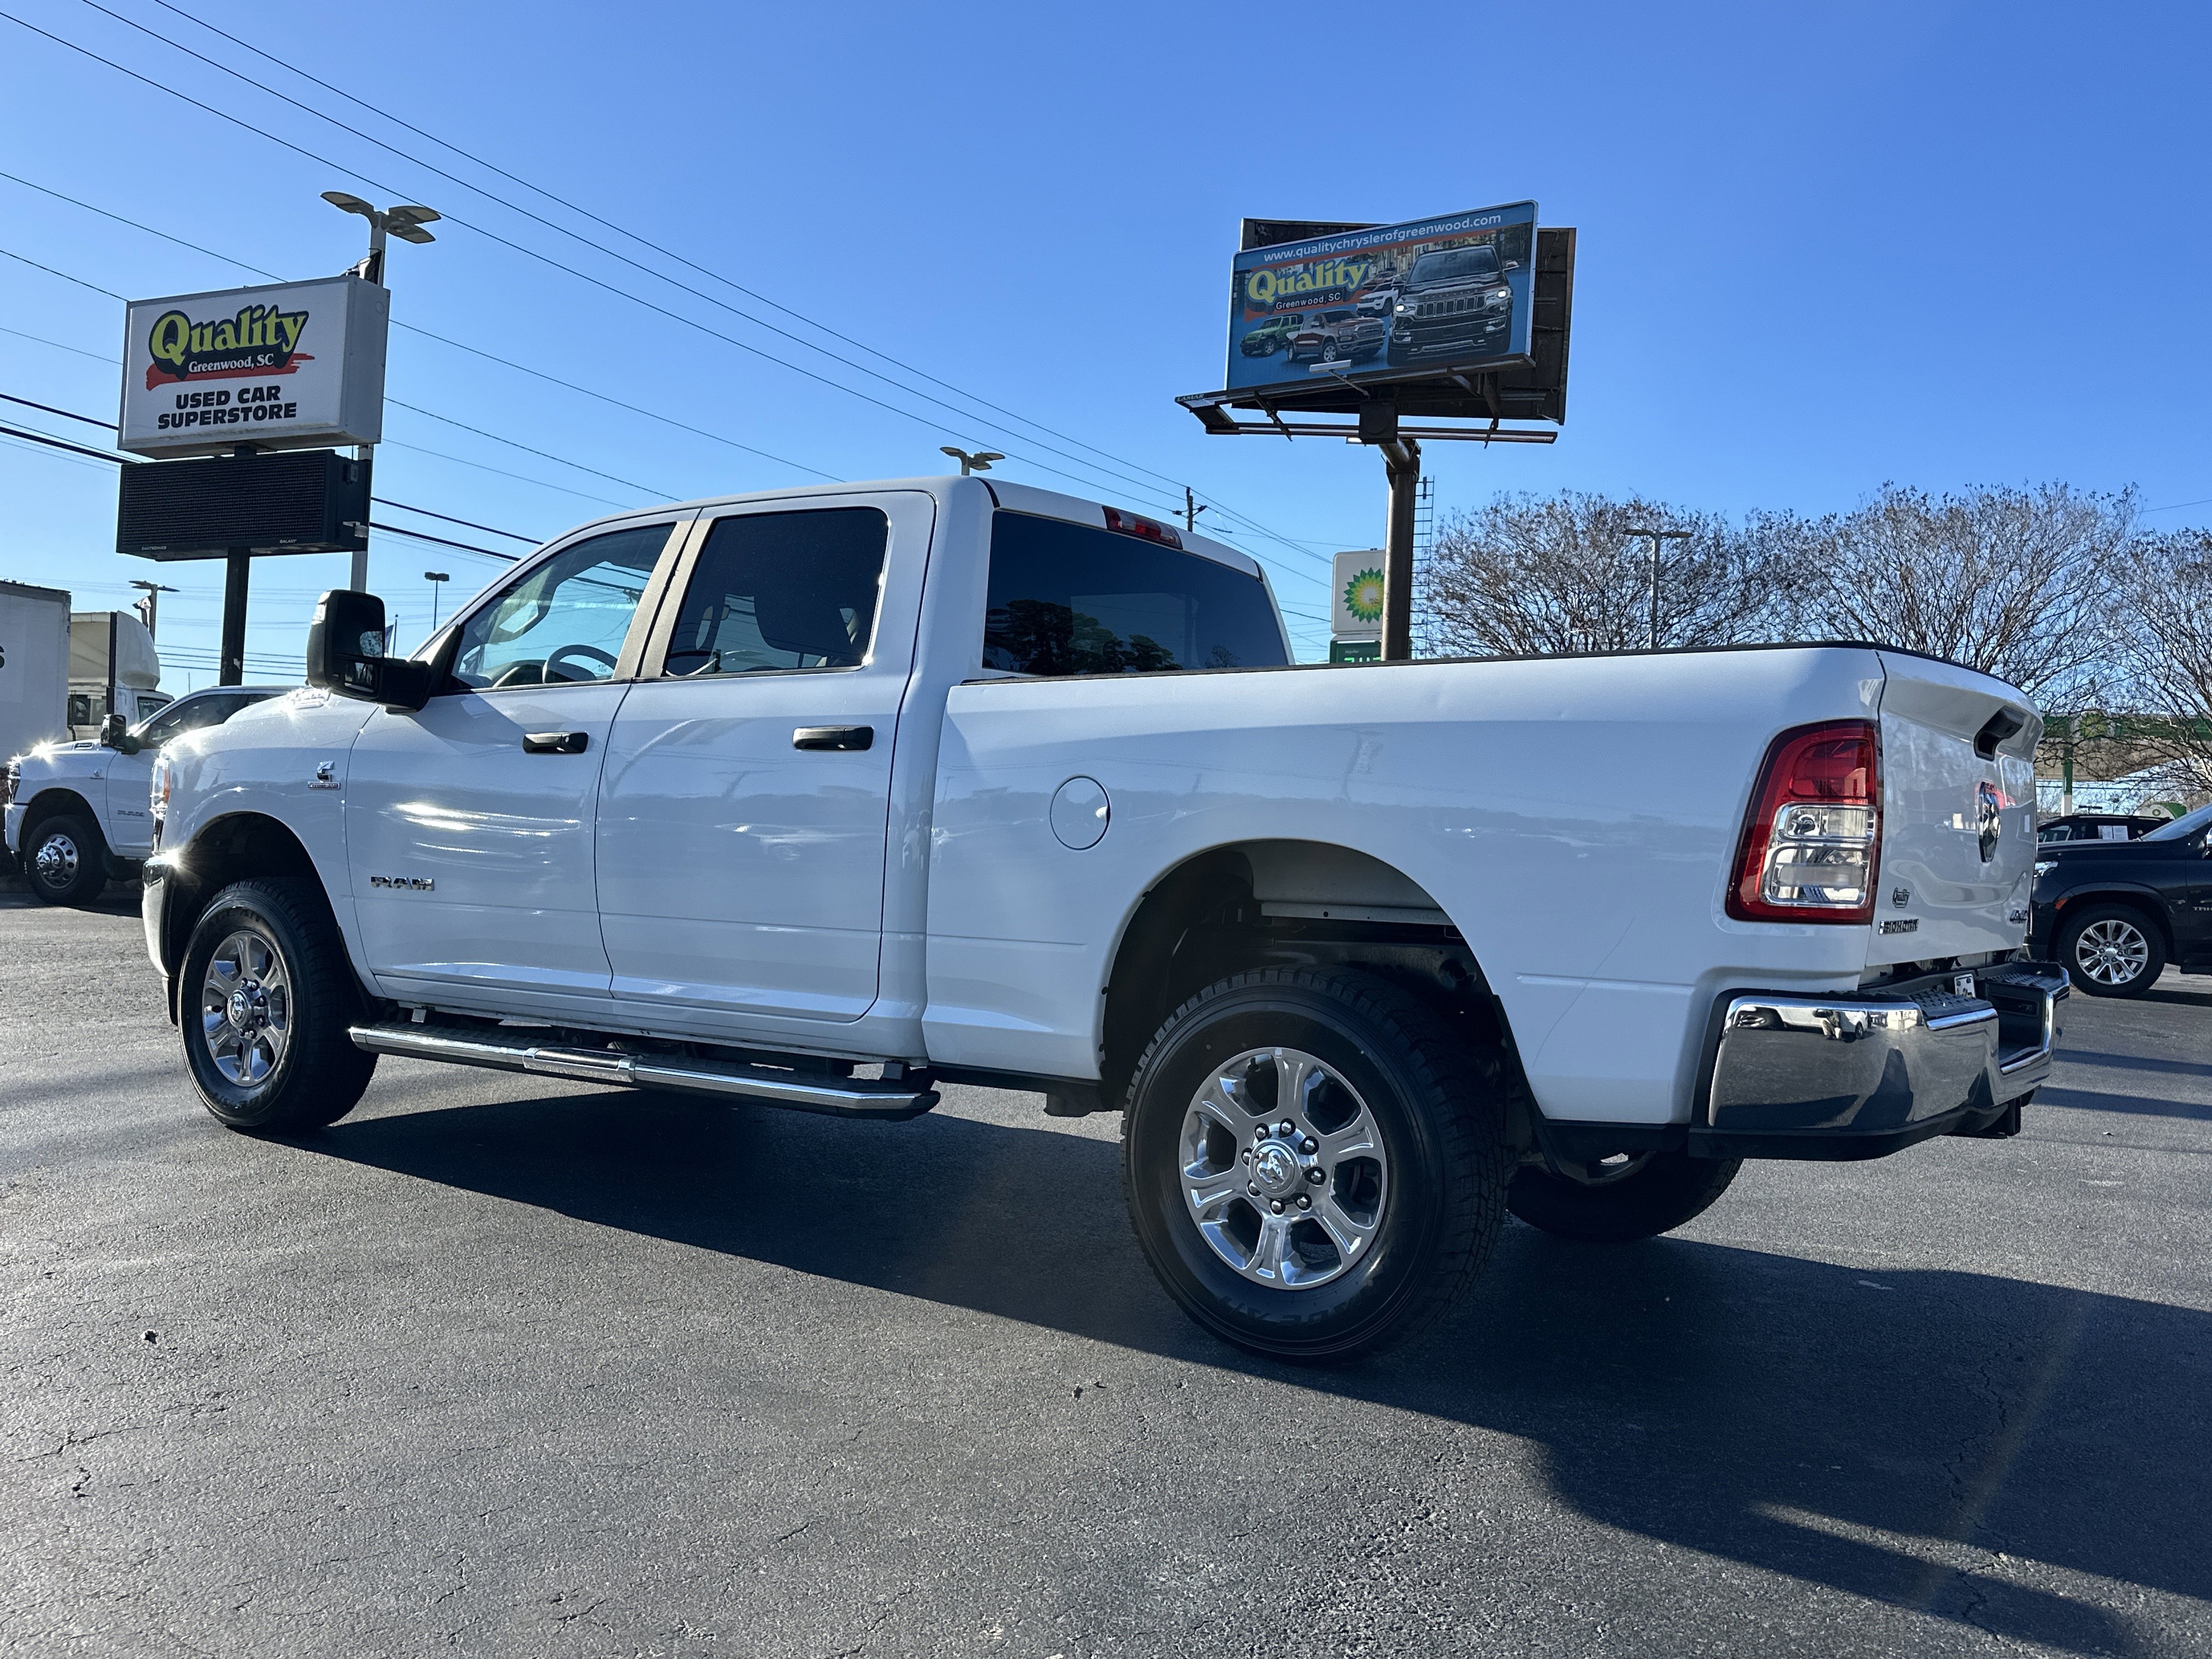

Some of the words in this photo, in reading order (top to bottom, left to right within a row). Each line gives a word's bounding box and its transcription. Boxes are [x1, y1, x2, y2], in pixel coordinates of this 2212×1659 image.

[1264, 215, 1501, 261] www.qualitychryslerofgreenwood.com
[1248, 260, 1369, 304] Quality
[1276, 295, 1327, 311] Greenwood,
[1328, 292, 1341, 302] SC
[150, 306, 308, 366] Quality
[188, 355, 255, 373] Greenwood,
[256, 353, 274, 367] SC
[176, 390, 230, 409] USED
[237, 385, 281, 404] CAR
[157, 402, 297, 430] SUPERSTORE
[370, 875, 435, 891] RAM
